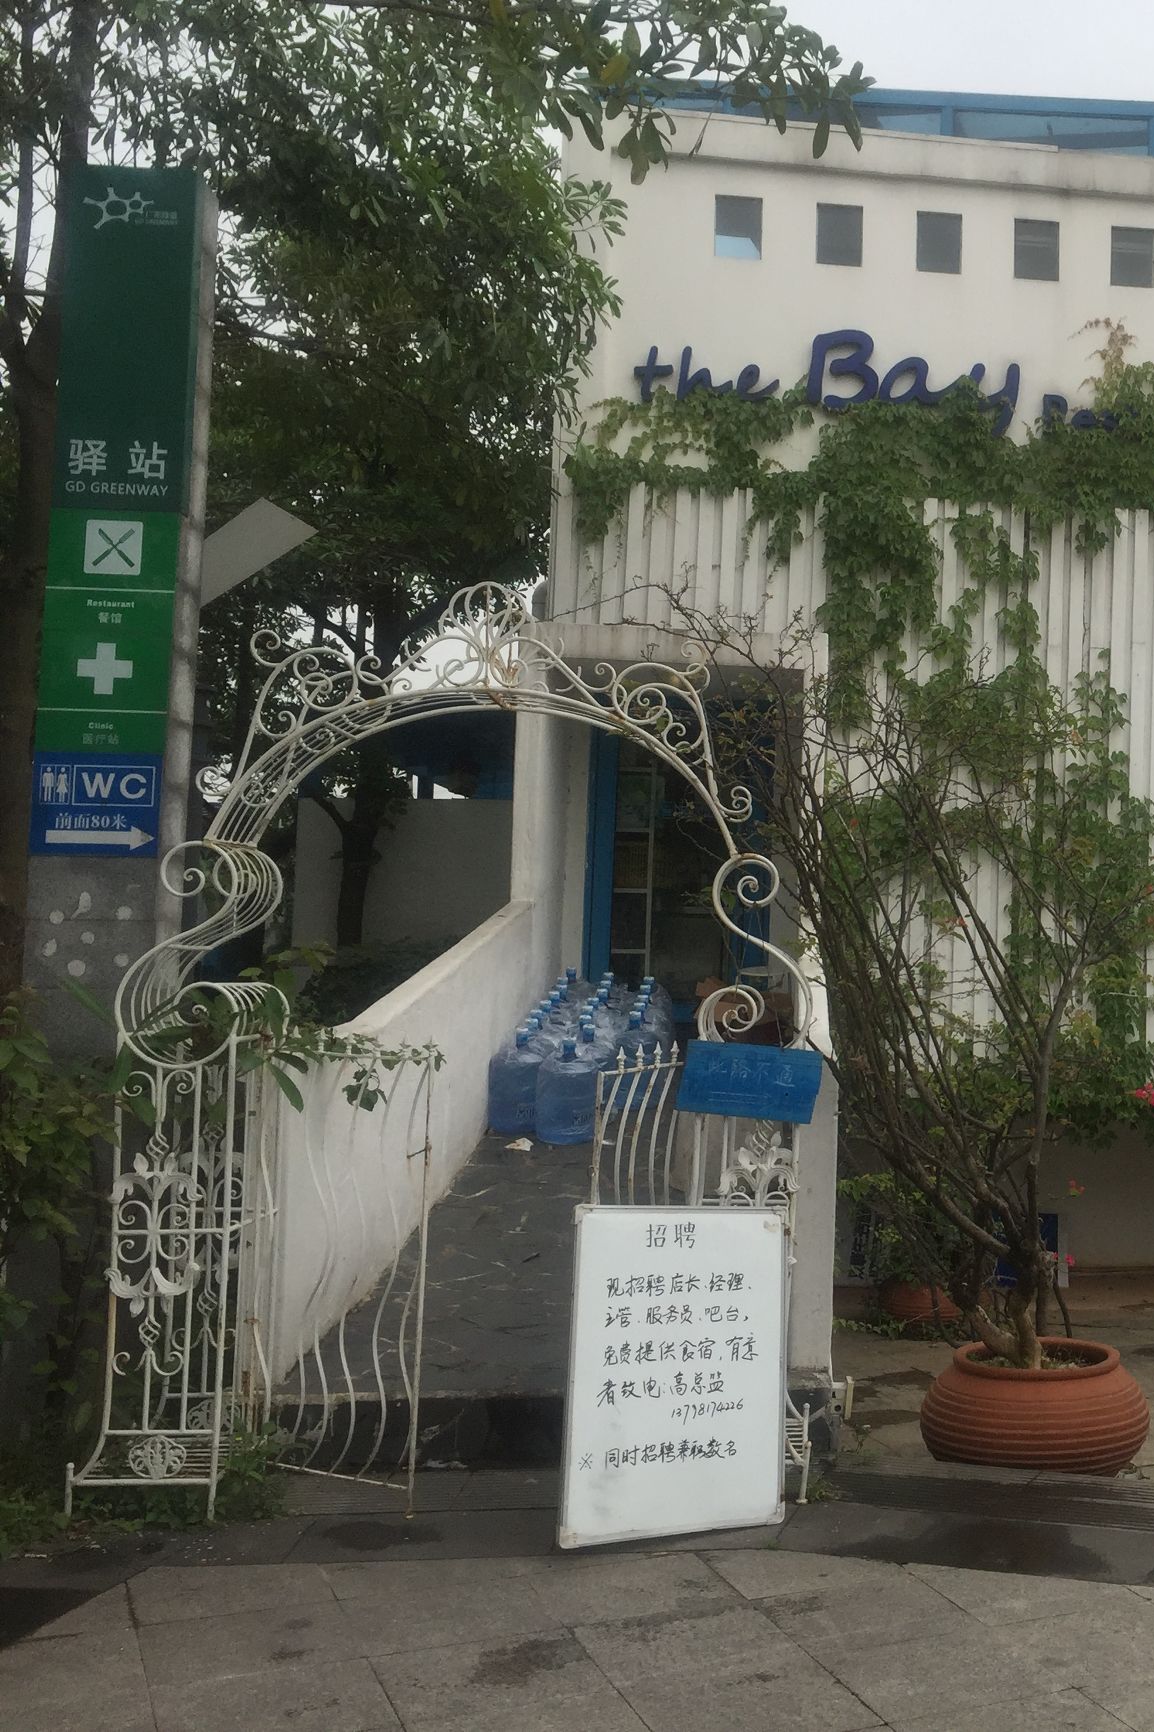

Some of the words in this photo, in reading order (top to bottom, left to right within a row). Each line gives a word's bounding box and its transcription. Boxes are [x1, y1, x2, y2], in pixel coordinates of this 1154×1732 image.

[634, 345, 780, 401] the
[807, 329, 1021, 440] Bay
[68, 439, 168, 480] 驿站
[65, 480, 87, 493] GD
[90, 481, 169, 497] GREENWAY
[86, 599, 135, 608] Restaurant
[81, 771, 147, 800] WC
[54, 812, 127, 830] 前面80米
[646, 1221, 697, 1249] 招聘
